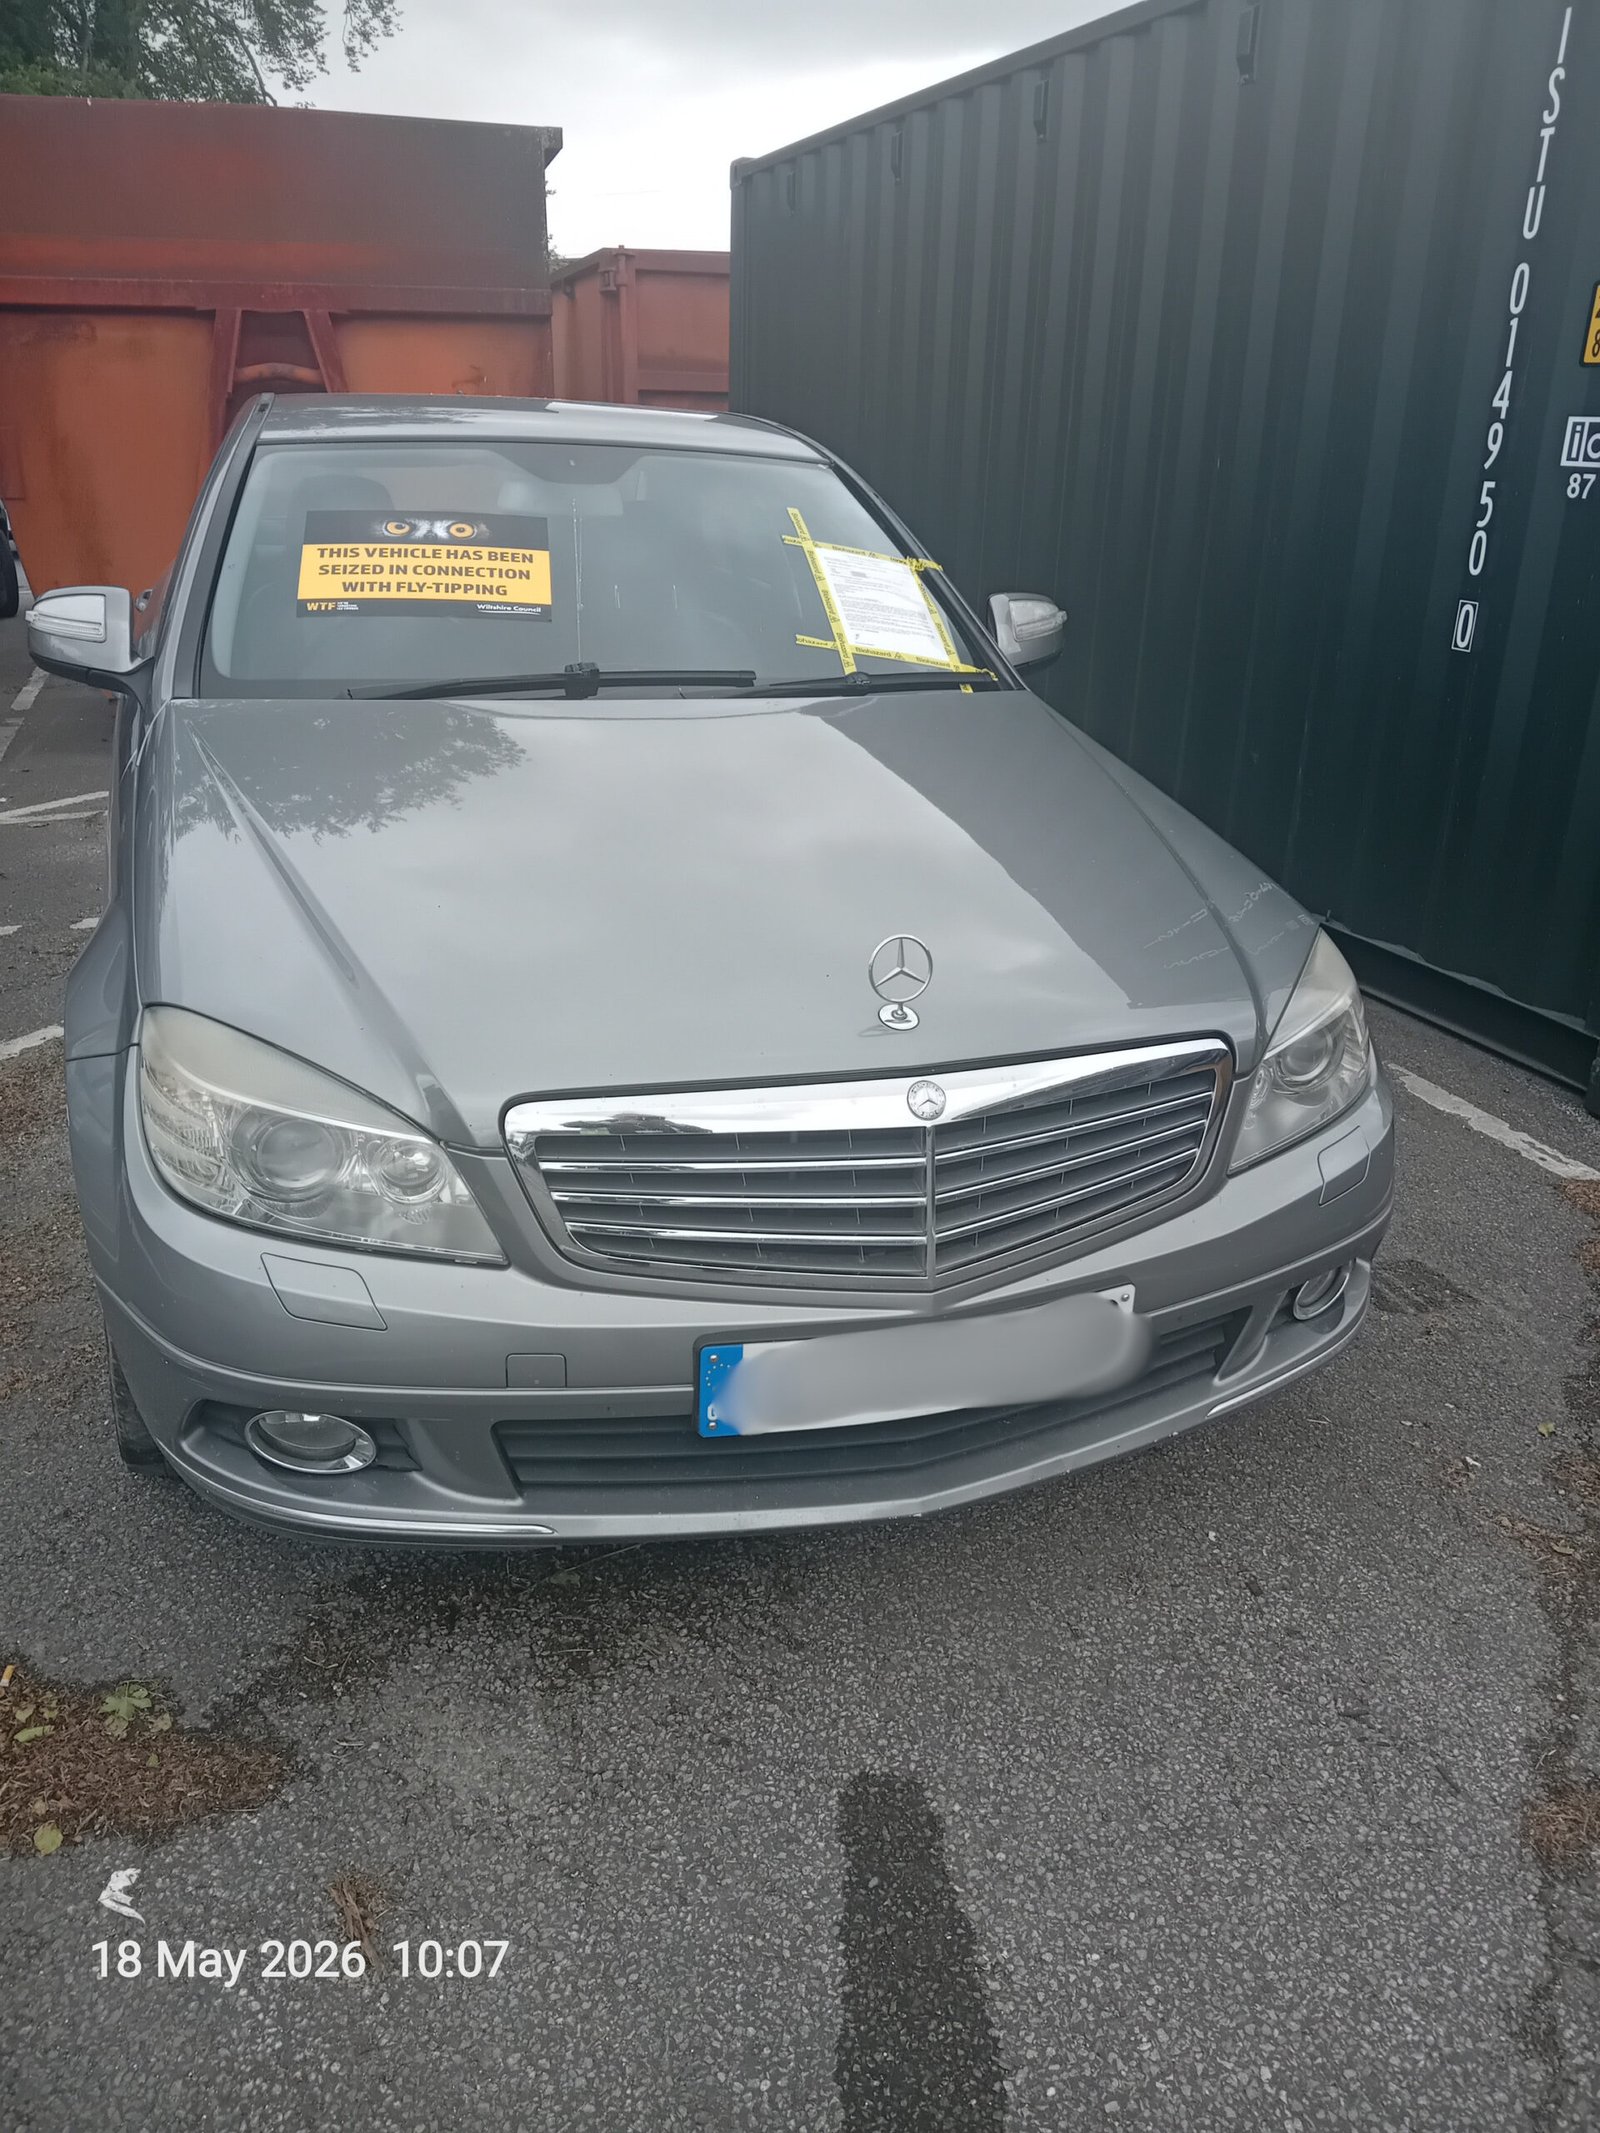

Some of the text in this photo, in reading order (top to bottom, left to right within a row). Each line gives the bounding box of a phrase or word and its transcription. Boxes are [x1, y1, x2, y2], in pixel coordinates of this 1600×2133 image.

[1523, 7, 1572, 240] ISTU
[1566, 473, 1596, 499] 87
[317, 548, 534, 563] THIS VEHICLE HAS BEEN
[318, 564, 531, 580] SEIZED IN CONNECTION
[342, 581, 508, 596] WITH FLY-TIPPING
[306, 602, 336, 611] WTF
[476, 603, 542, 613] Wiltshire Council
